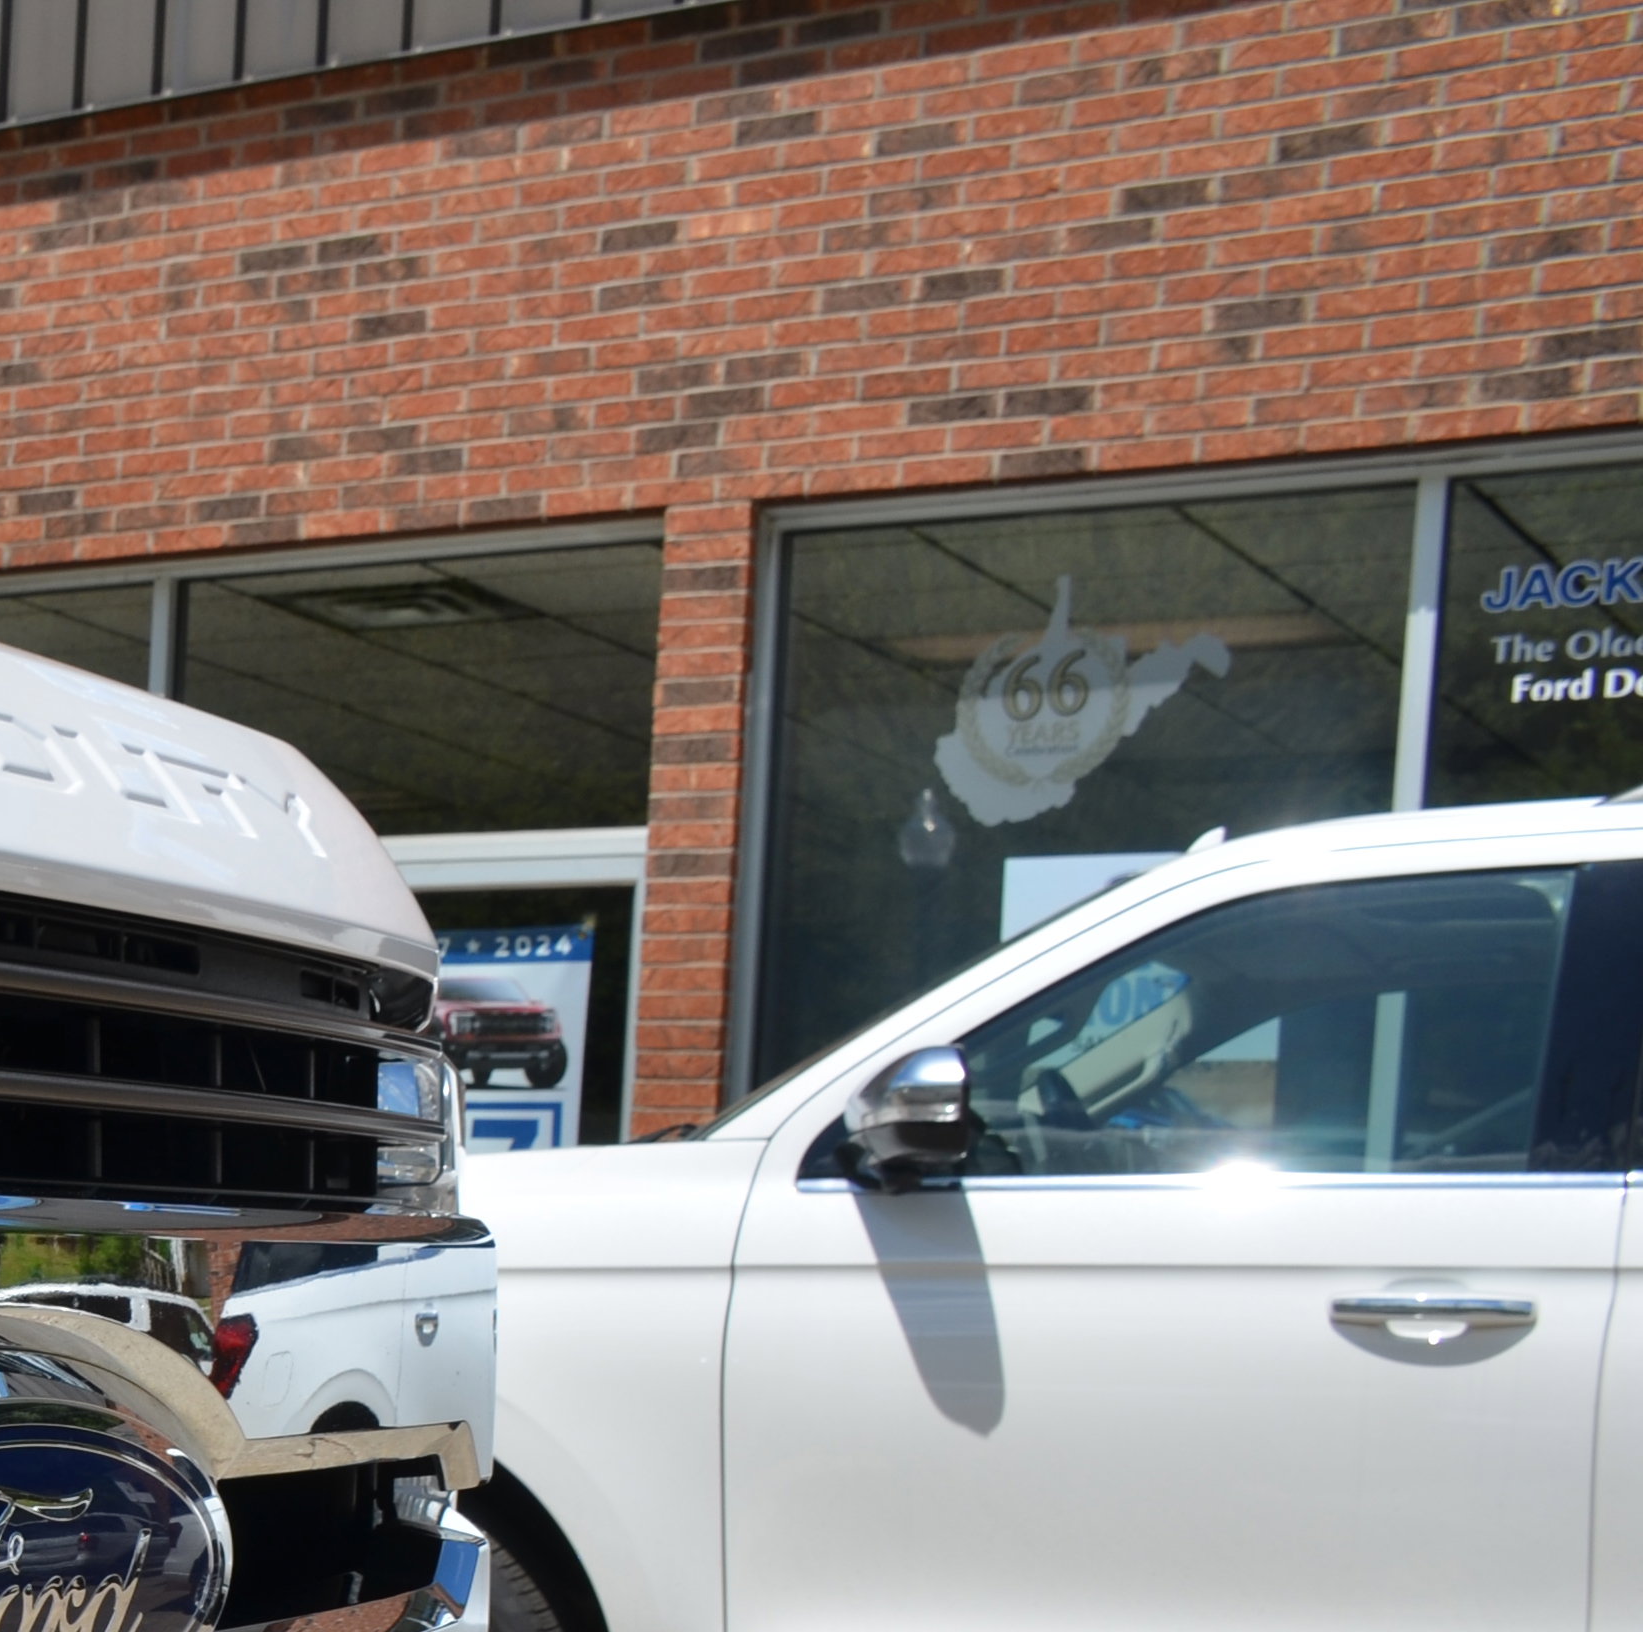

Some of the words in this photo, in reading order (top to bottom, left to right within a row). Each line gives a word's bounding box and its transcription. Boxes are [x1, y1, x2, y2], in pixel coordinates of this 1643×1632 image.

[1480, 556, 1643, 614] JACK
[1490, 632, 1557, 664] The
[1002, 648, 1090, 722] 66
[1510, 667, 1595, 704] Ford
[1007, 718, 1081, 748] YEARS
[494, 934, 573, 959] 2024
